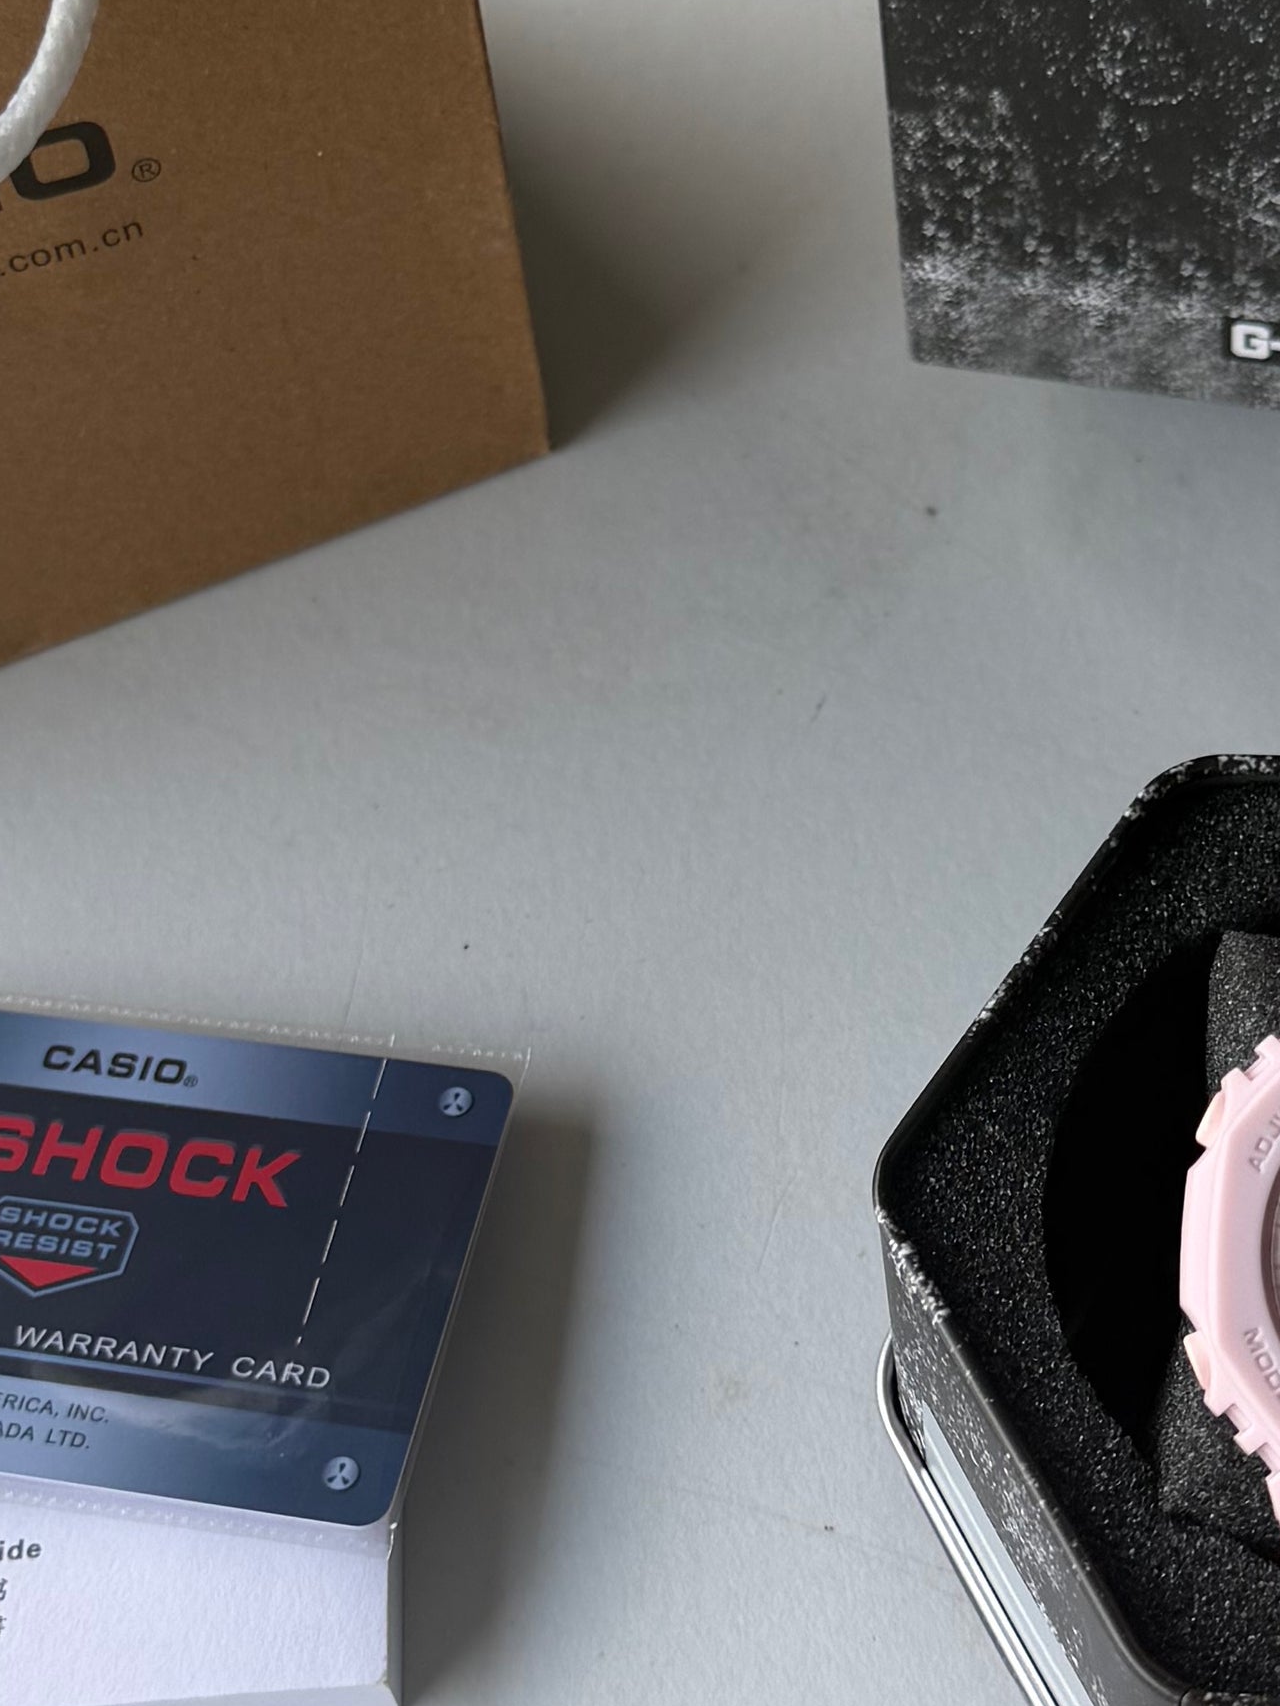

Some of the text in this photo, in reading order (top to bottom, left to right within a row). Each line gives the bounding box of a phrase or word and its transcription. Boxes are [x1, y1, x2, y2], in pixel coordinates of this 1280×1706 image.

[15, 1324, 215, 1372] WARRANTY
[231, 1356, 333, 1390] CARD
[66, 1402, 110, 1424] INC.
[43, 1426, 91, 1450] LTD.
